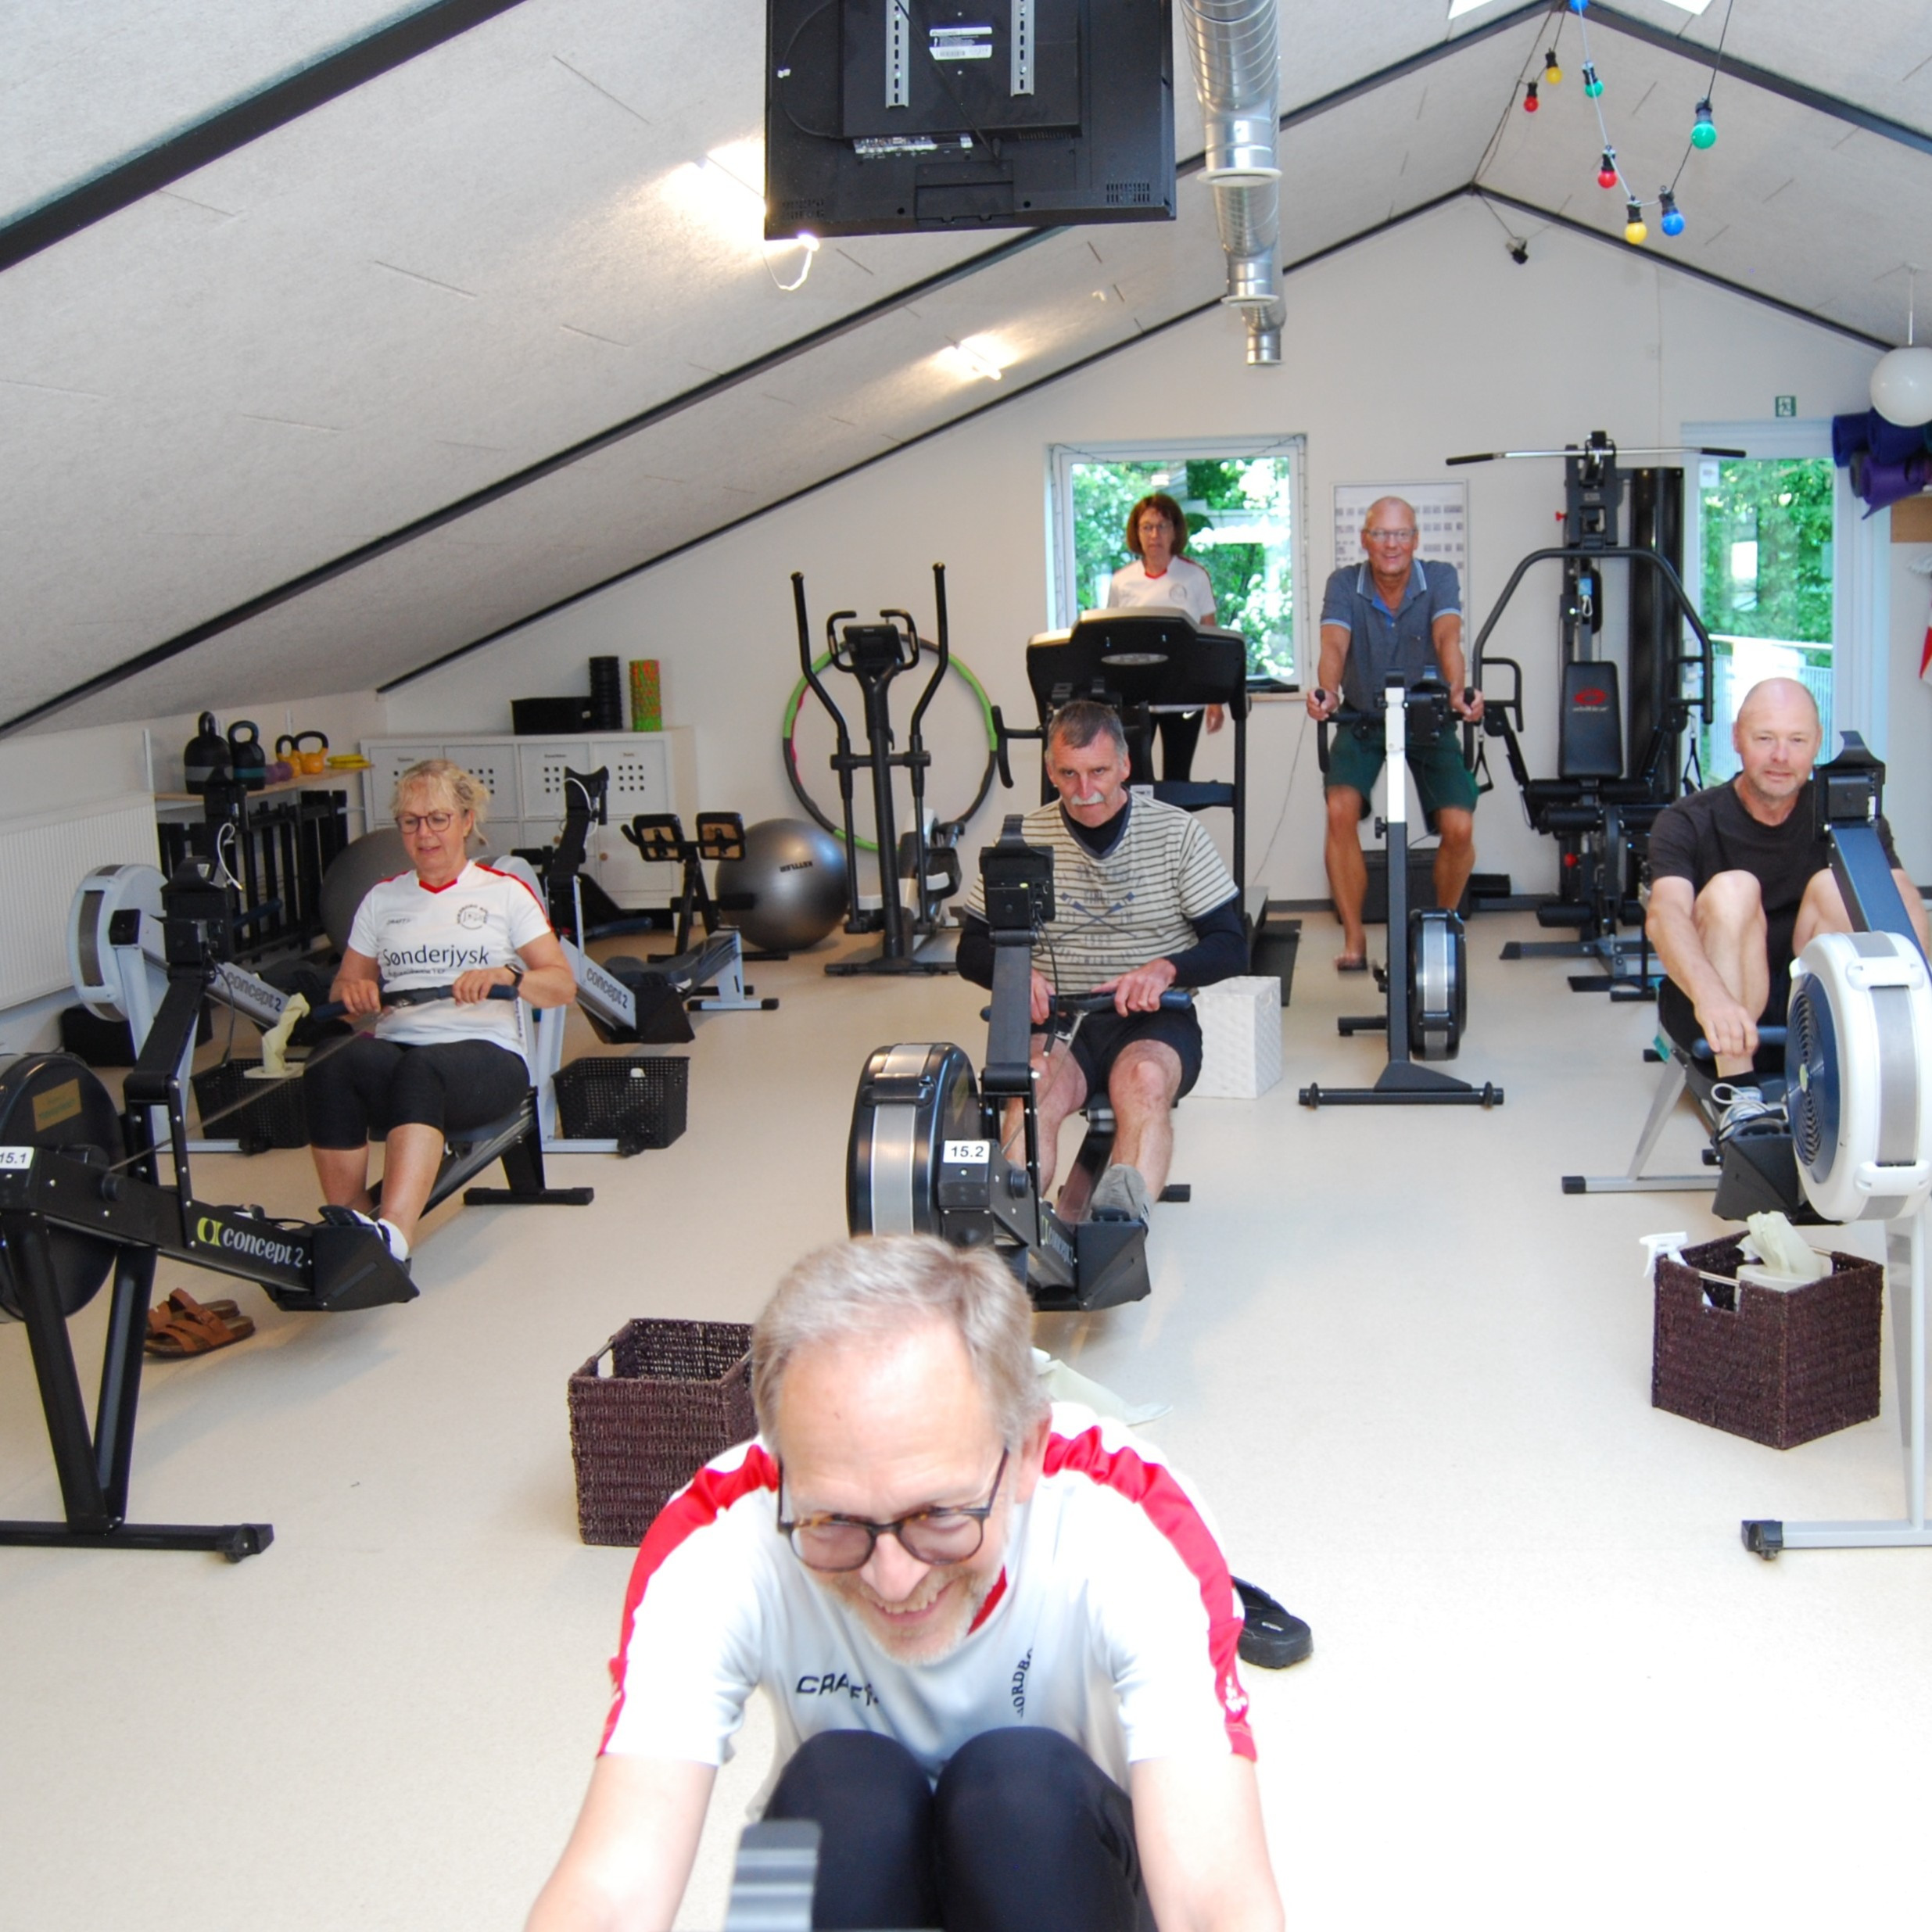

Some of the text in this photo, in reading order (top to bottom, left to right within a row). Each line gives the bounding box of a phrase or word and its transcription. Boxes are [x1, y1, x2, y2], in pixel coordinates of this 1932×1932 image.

[780, 861, 813, 873] KETTLER
[382, 944, 489, 968] Sønderjysk
[951, 1145, 984, 1157] 15.2
[0, 1152, 27, 1163] 15.1
[223, 1228, 292, 1264] concept
